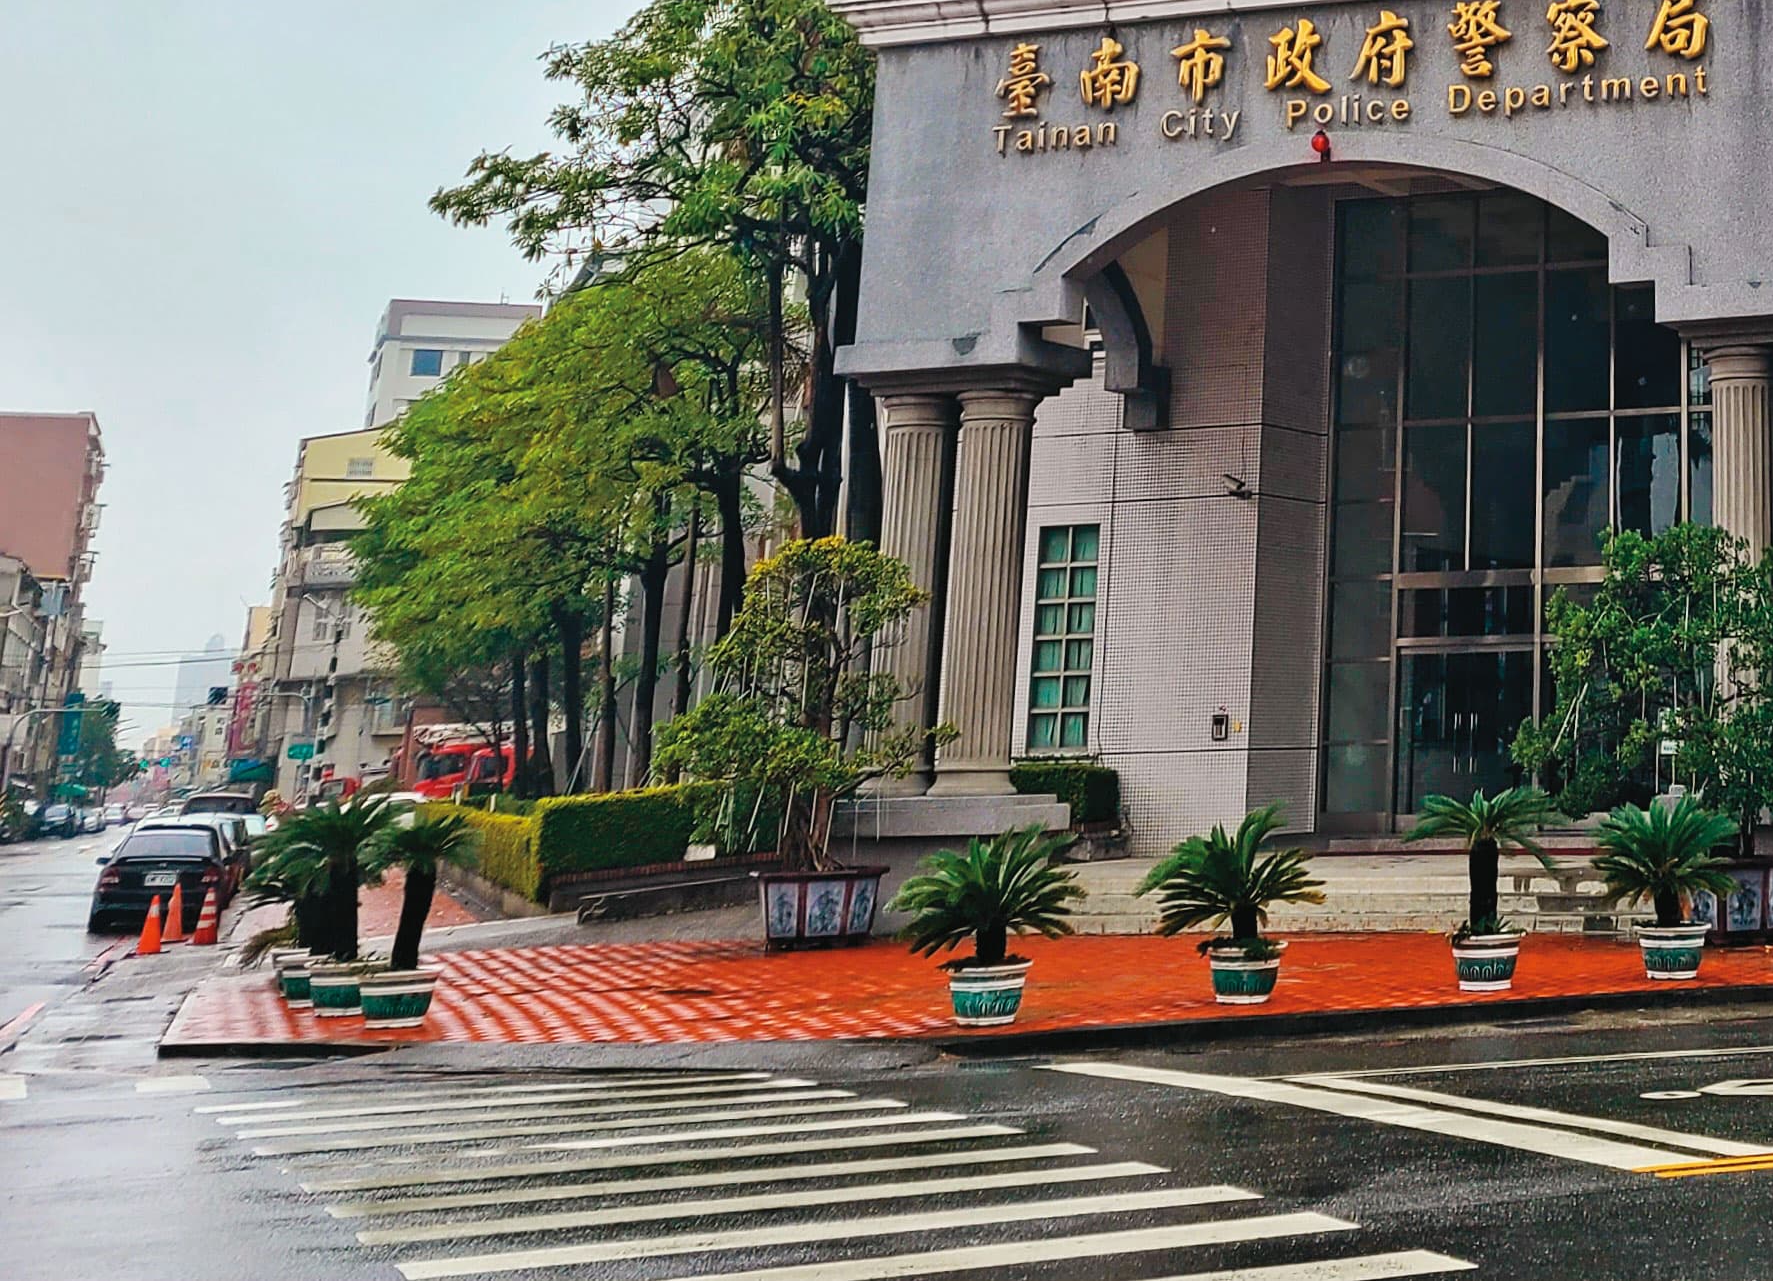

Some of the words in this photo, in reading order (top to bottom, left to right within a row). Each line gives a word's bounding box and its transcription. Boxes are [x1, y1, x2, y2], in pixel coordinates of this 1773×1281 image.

[992, 121, 1117, 155] Tainan
[1161, 108, 1241, 141] City
[1286, 94, 1410, 130] Police
[1448, 65, 1707, 117] Department
